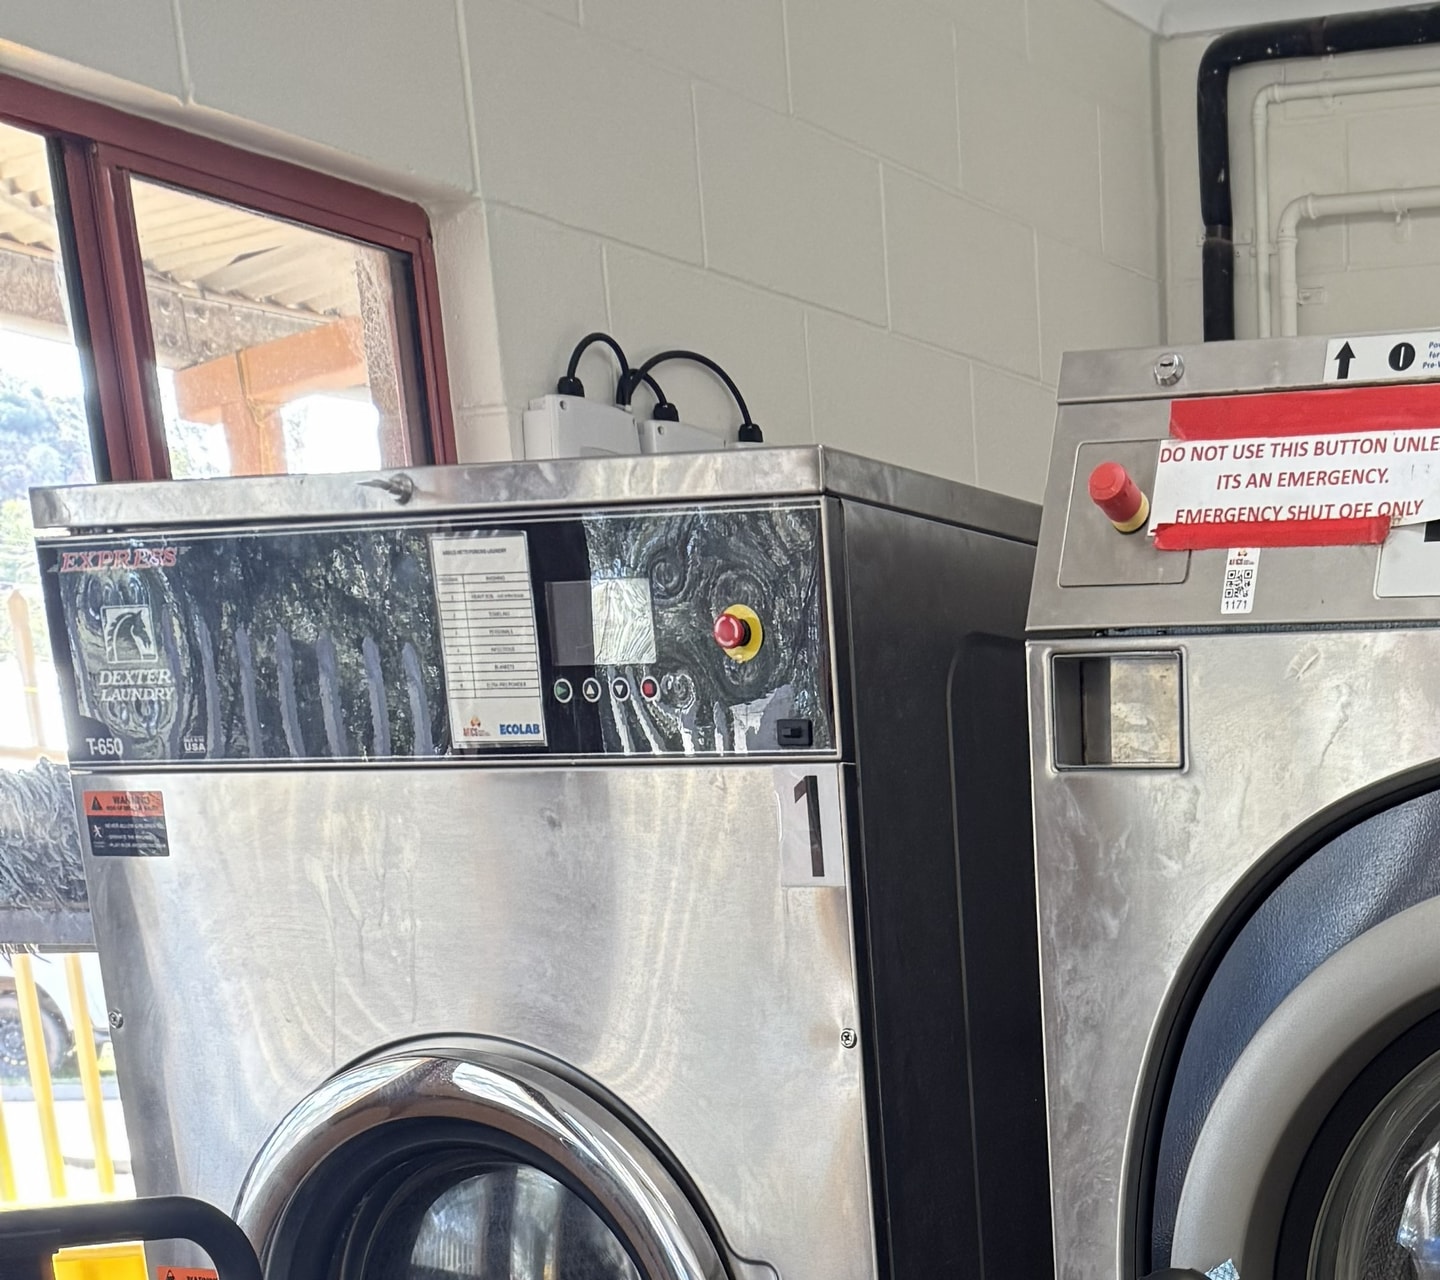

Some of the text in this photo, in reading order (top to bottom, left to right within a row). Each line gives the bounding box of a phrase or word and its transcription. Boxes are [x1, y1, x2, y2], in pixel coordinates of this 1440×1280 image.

[1160, 447, 1186, 463] DO
[1190, 445, 1229, 461] NOT
[1232, 443, 1266, 460] USE
[1270, 441, 1309, 458] THIS
[1313, 438, 1387, 456] BUTTON
[1216, 467, 1389, 490] ITS AN EMERGENCY.
[1175, 499, 1425, 524] EMERGENCY SHUT OFF ONLY
[60, 547, 178, 573] EXPRESS
[1225, 600, 1247, 610] 1171
[99, 668, 172, 686] DEXTER
[101, 687, 176, 702] LAUNDRY
[499, 723, 541, 735] ECOLAB
[86, 738, 123, 755] T-650
[184, 742, 206, 751] USA
[793, 775, 825, 877] 1
